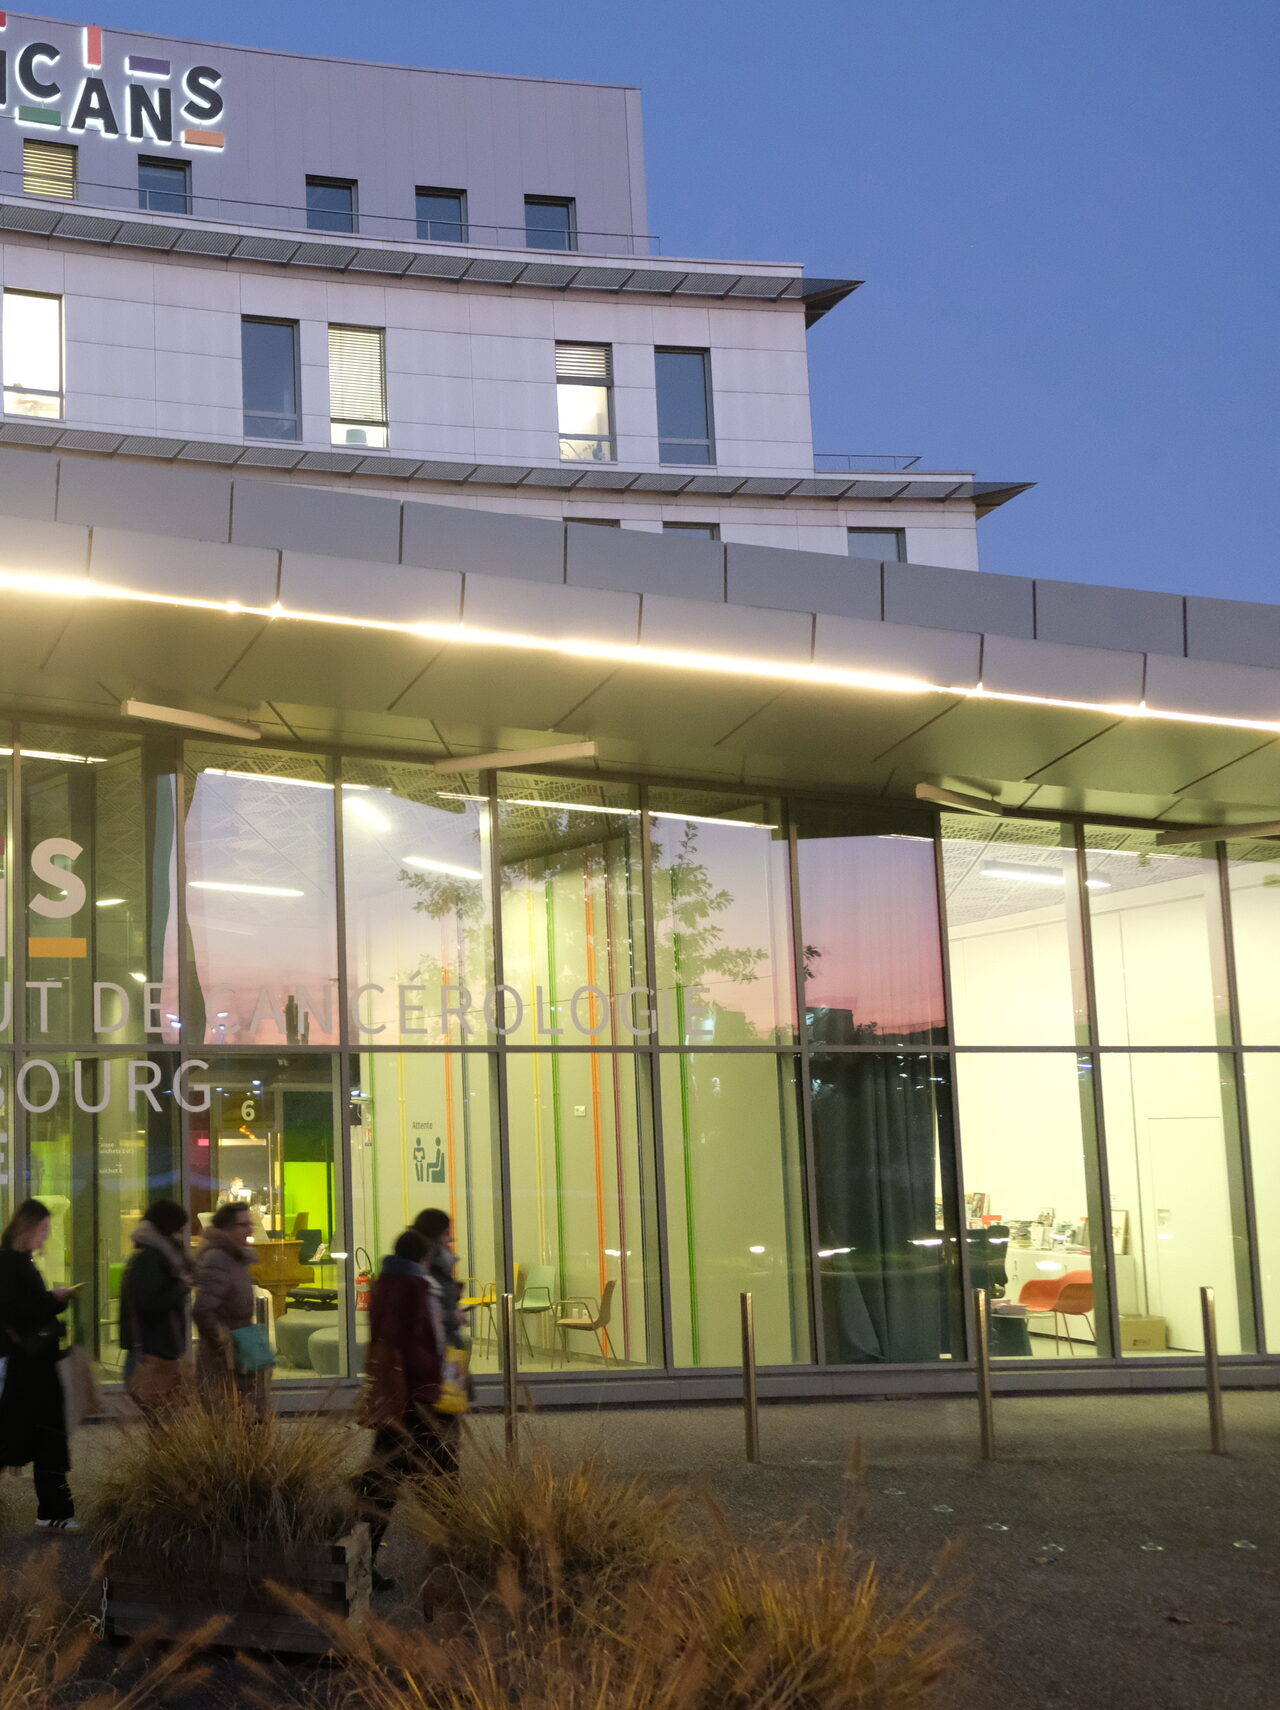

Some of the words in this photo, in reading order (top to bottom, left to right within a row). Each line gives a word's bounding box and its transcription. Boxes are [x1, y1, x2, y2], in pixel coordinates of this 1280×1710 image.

[94, 982, 177, 1034] DE
[207, 969, 714, 1037] CANCÉROLOGIE
[241, 1100, 255, 1121] 6
